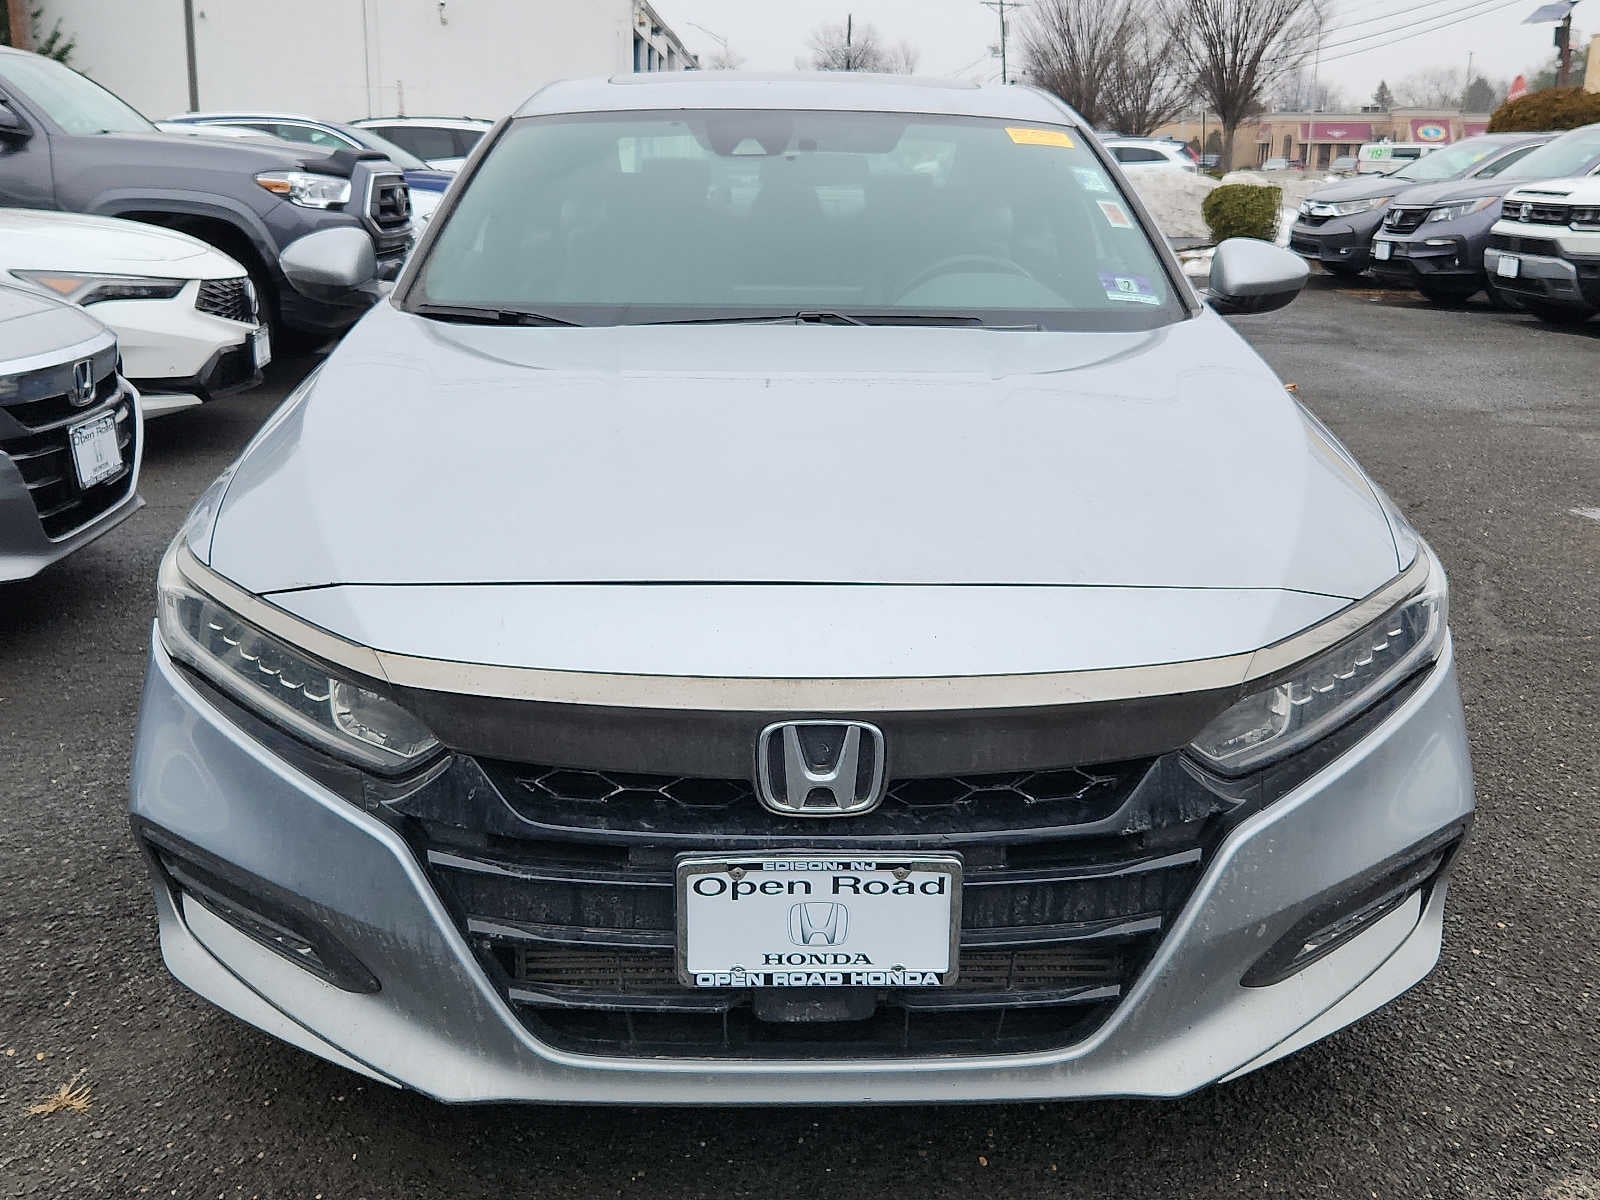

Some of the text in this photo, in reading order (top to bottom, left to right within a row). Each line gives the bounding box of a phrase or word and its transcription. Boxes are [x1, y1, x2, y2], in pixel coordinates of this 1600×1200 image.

[762, 861, 876, 871] EDISON, NJ
[693, 876, 945, 900] Open Road
[762, 953, 873, 965] HONDA
[696, 972, 940, 986] OPEN ROAD HONDA
